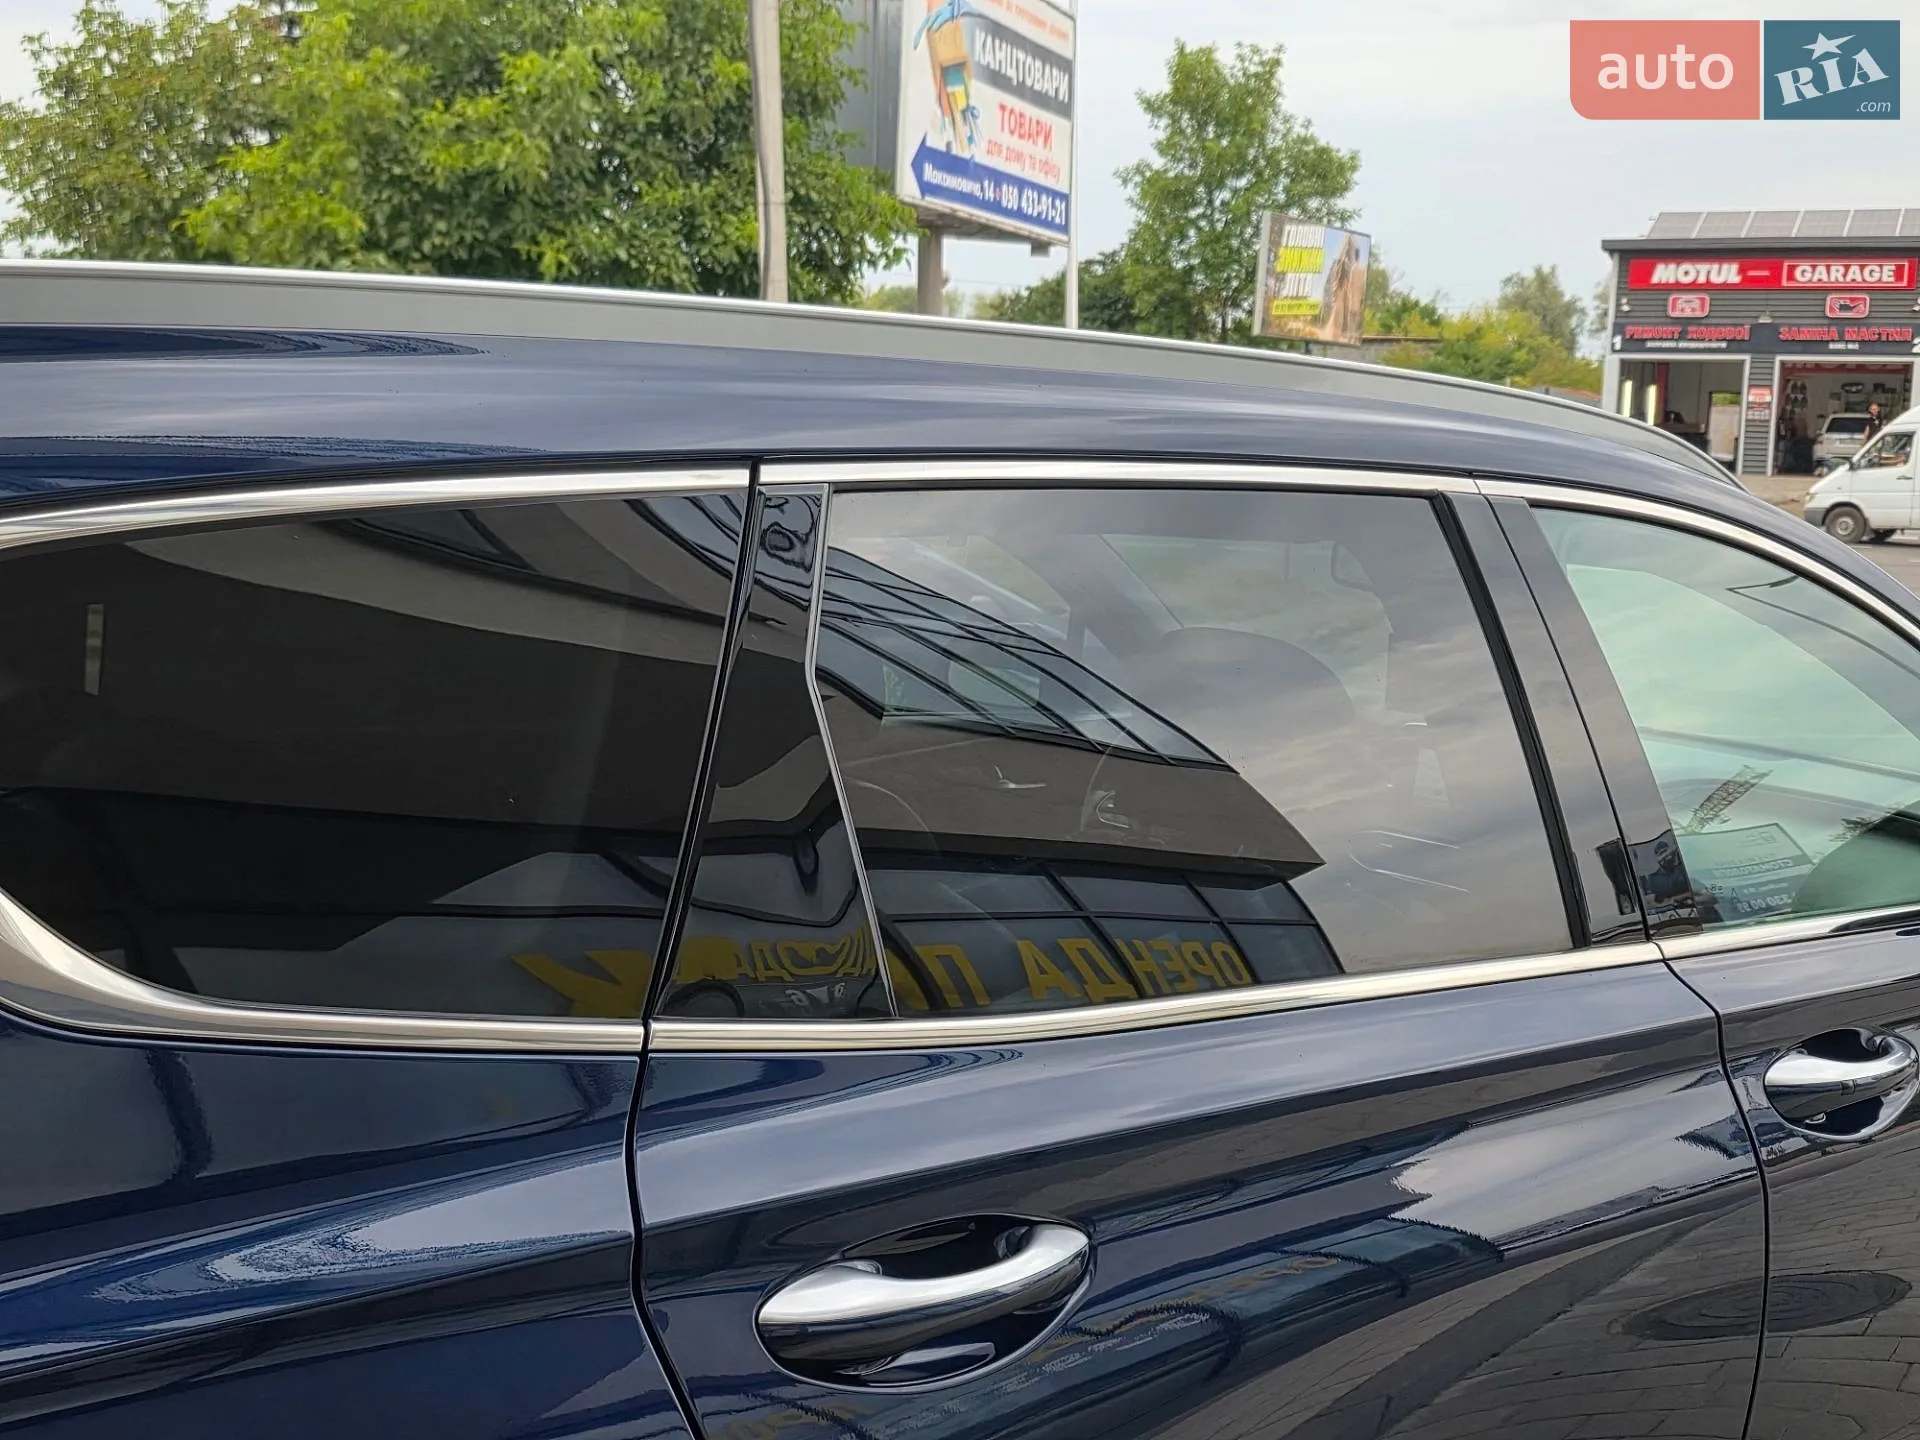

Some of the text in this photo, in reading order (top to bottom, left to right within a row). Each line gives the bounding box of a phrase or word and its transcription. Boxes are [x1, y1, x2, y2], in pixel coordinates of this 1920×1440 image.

[974, 29, 1070, 104] КАНЦТОВАРИ
[998, 102, 1053, 153] ТОВАРИ
[1001, 183, 1019, 211] 050
[1651, 262, 1897, 285] MOTUL GARAGE
[1612, 334, 1622, 350] 1
